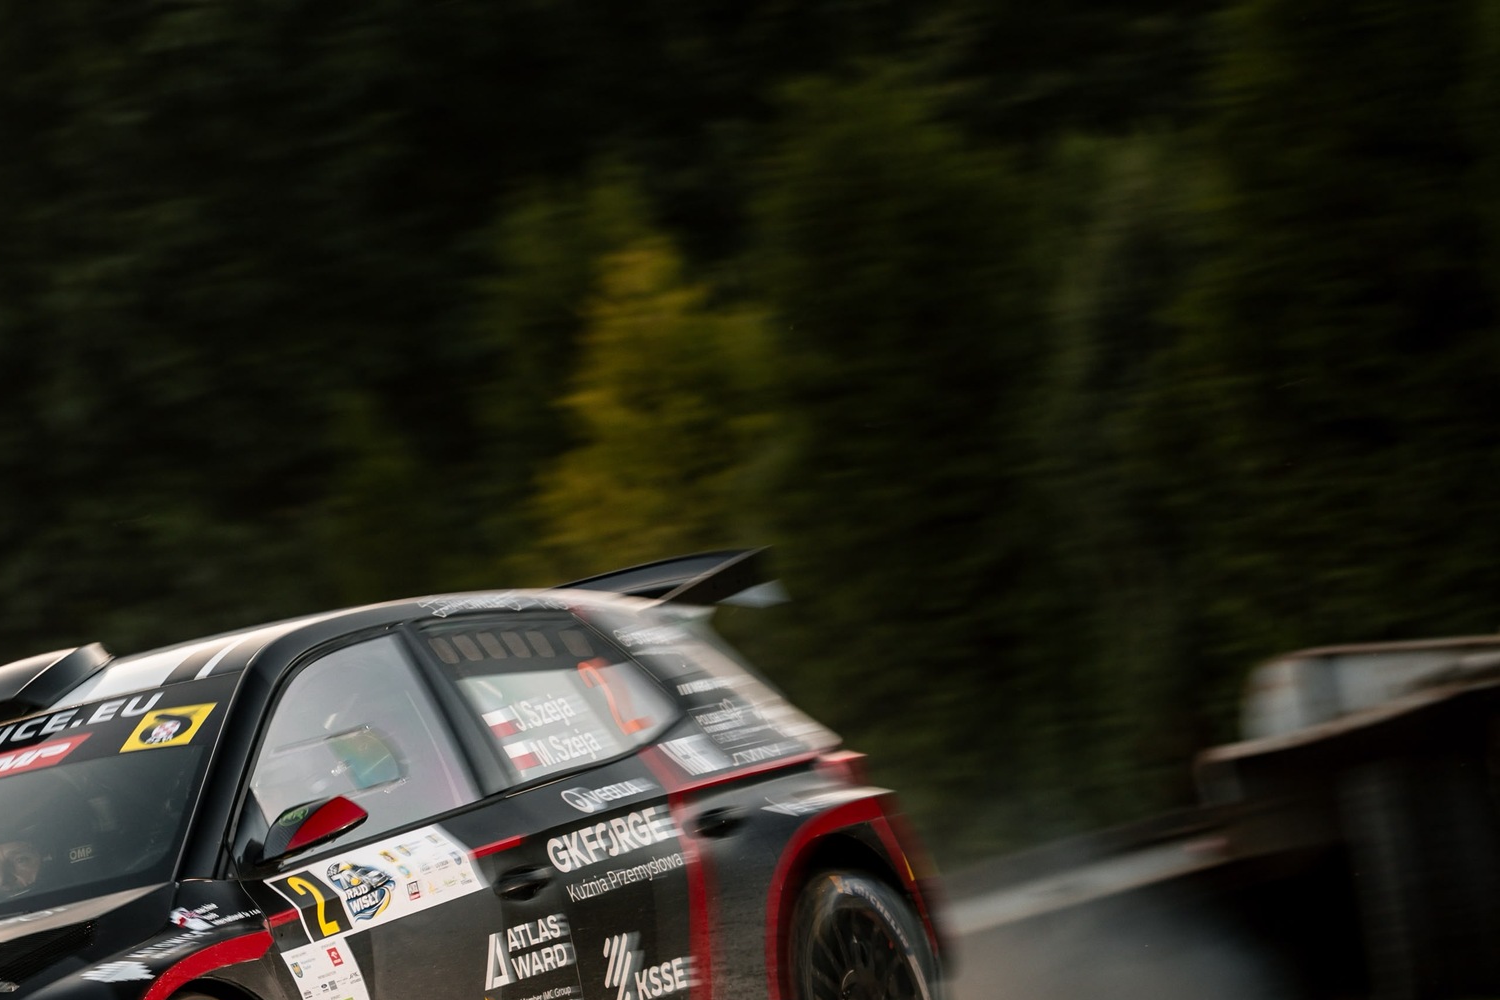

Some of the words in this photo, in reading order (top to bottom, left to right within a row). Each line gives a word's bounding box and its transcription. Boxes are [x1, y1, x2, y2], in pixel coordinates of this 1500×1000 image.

[577, 658, 655, 736] 2
[345, 883, 369, 900] RAJD
[566, 877, 609, 903] Kuźnia
[607, 851, 685, 889] Przemysłowa
[287, 875, 341, 938] 2
[506, 914, 562, 953] ATLAS
[511, 943, 569, 980] WARD
[554, 985, 572, 999] Group
